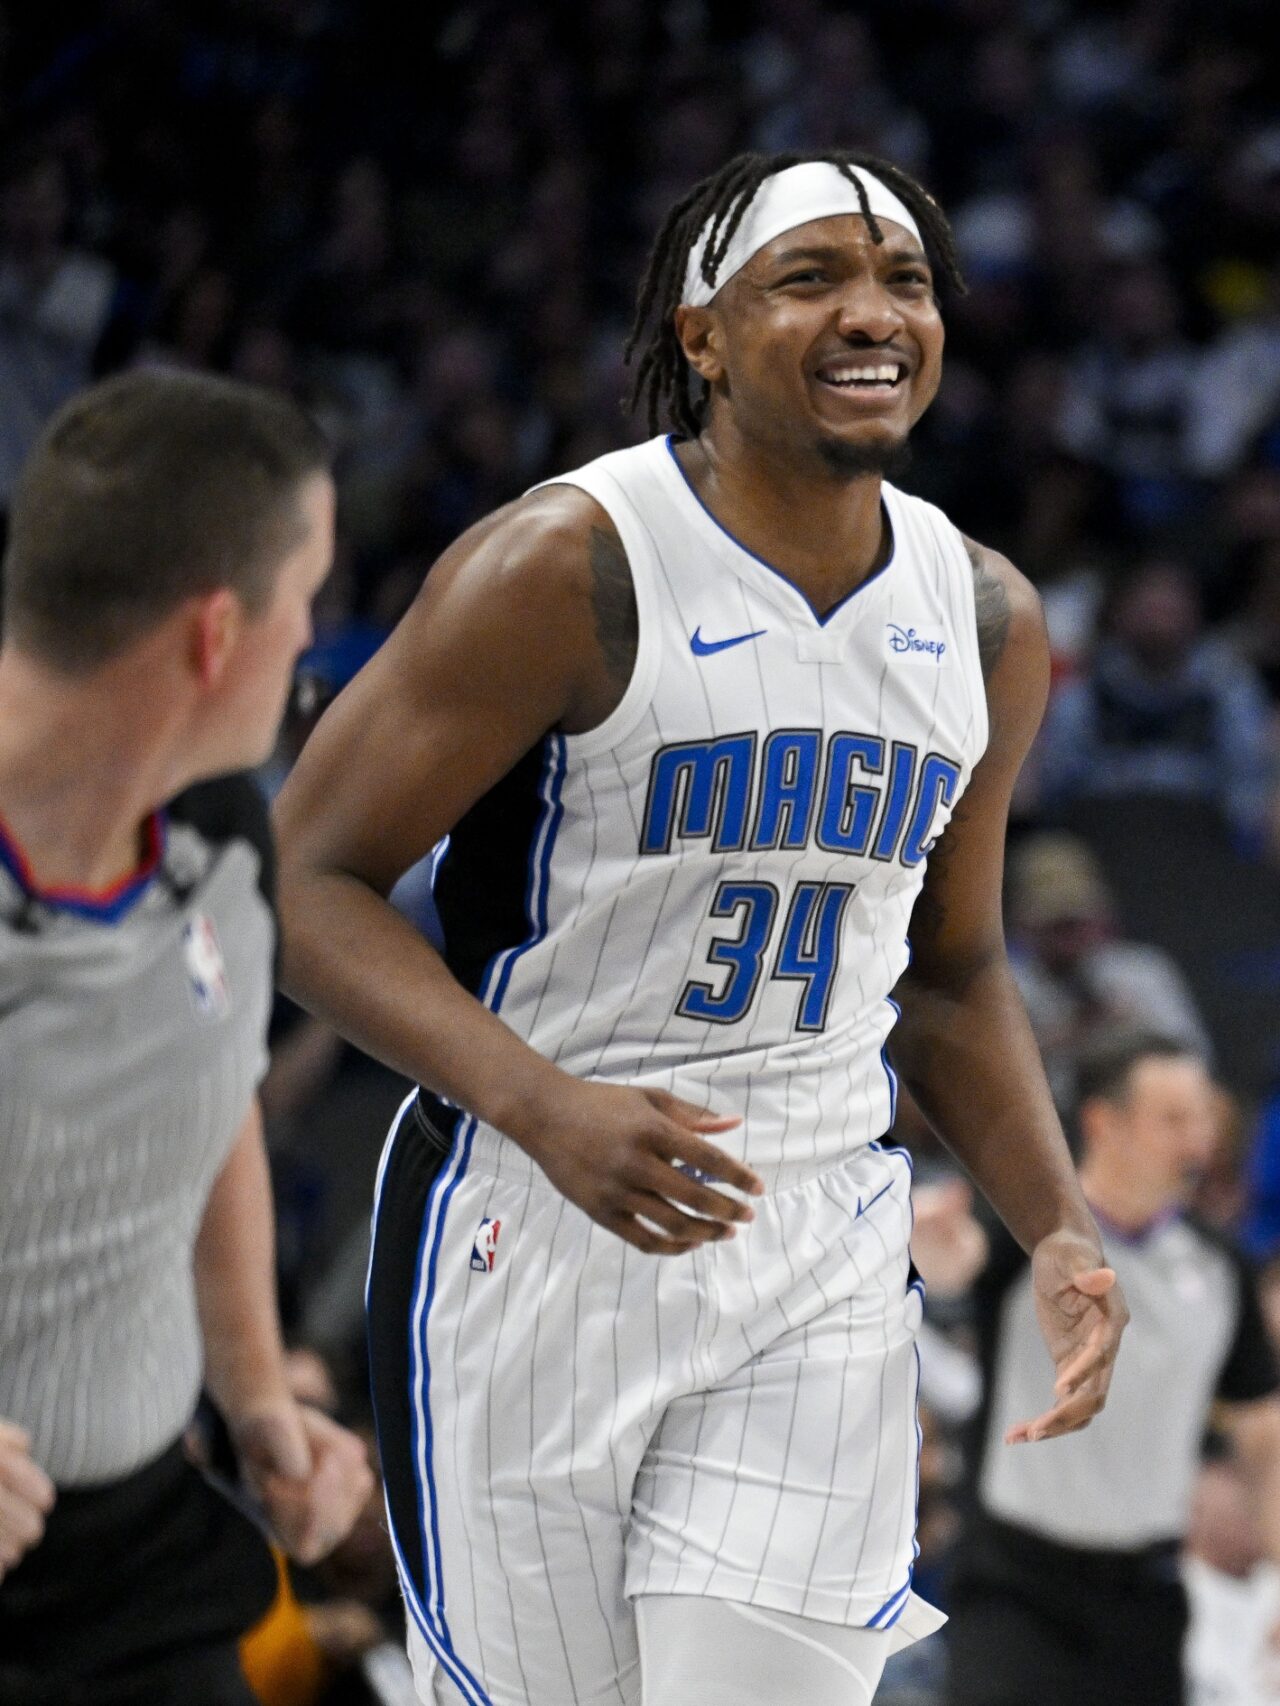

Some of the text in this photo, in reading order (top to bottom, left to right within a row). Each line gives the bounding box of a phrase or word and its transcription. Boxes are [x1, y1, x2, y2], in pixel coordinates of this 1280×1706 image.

[886, 623, 945, 663] Disney
[640, 728, 961, 868] MAGIC
[675, 880, 856, 1033] 34
